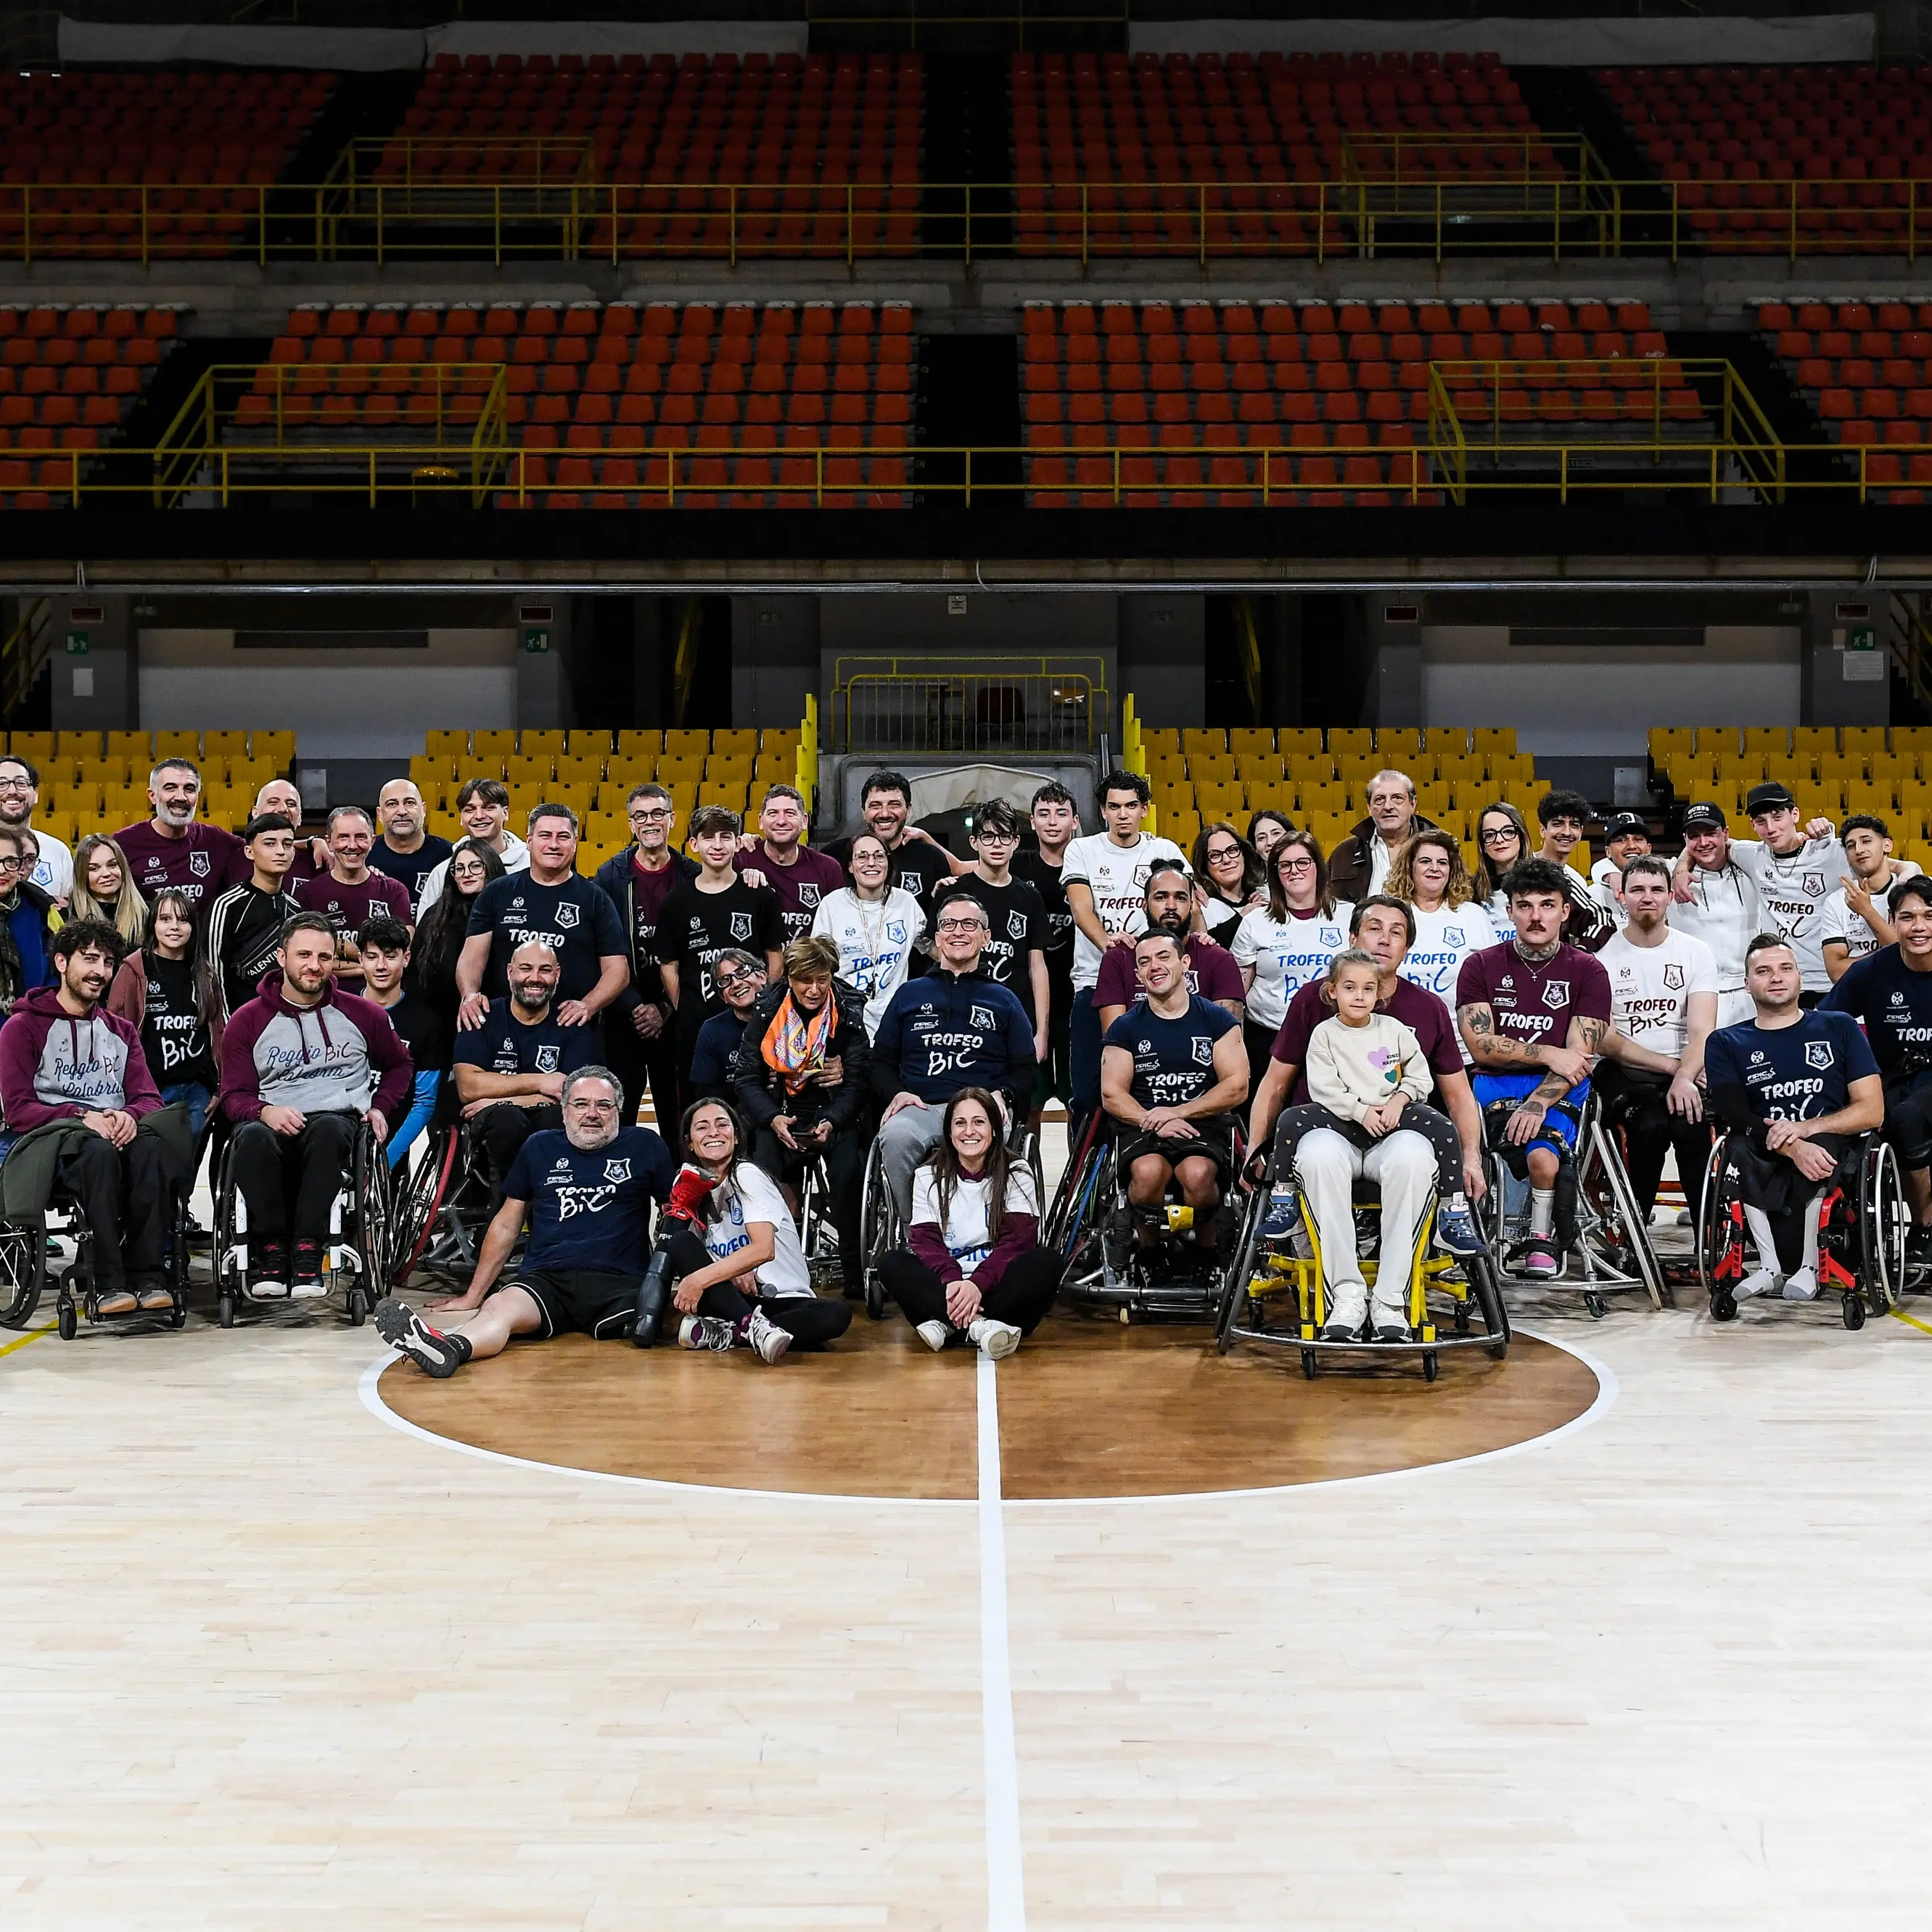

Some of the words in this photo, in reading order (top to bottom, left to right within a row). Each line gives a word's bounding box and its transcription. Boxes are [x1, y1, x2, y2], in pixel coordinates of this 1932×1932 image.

[1767, 900, 1814, 915] TROFEO
[509, 929, 564, 947] TROFEO
[981, 940, 1014, 957] OFEO
[247, 950, 278, 976] ALENTI
[1278, 954, 1333, 967] TROFEO
[1404, 953, 1456, 964] TROFEO
[1624, 999, 1677, 1013] TROFEO
[1500, 1013, 1553, 1030] TROFEO
[921, 1033, 983, 1048] TROFEO
[161, 1030, 205, 1070] BiC
[324, 1042, 353, 1064] BiC
[54, 1058, 102, 1082] Reggio
[927, 1048, 976, 1076] BiC
[1146, 1072, 1207, 1086] TROFEO
[1760, 1078, 1824, 1100] TROFEO
[559, 1192, 612, 1222] BiC
